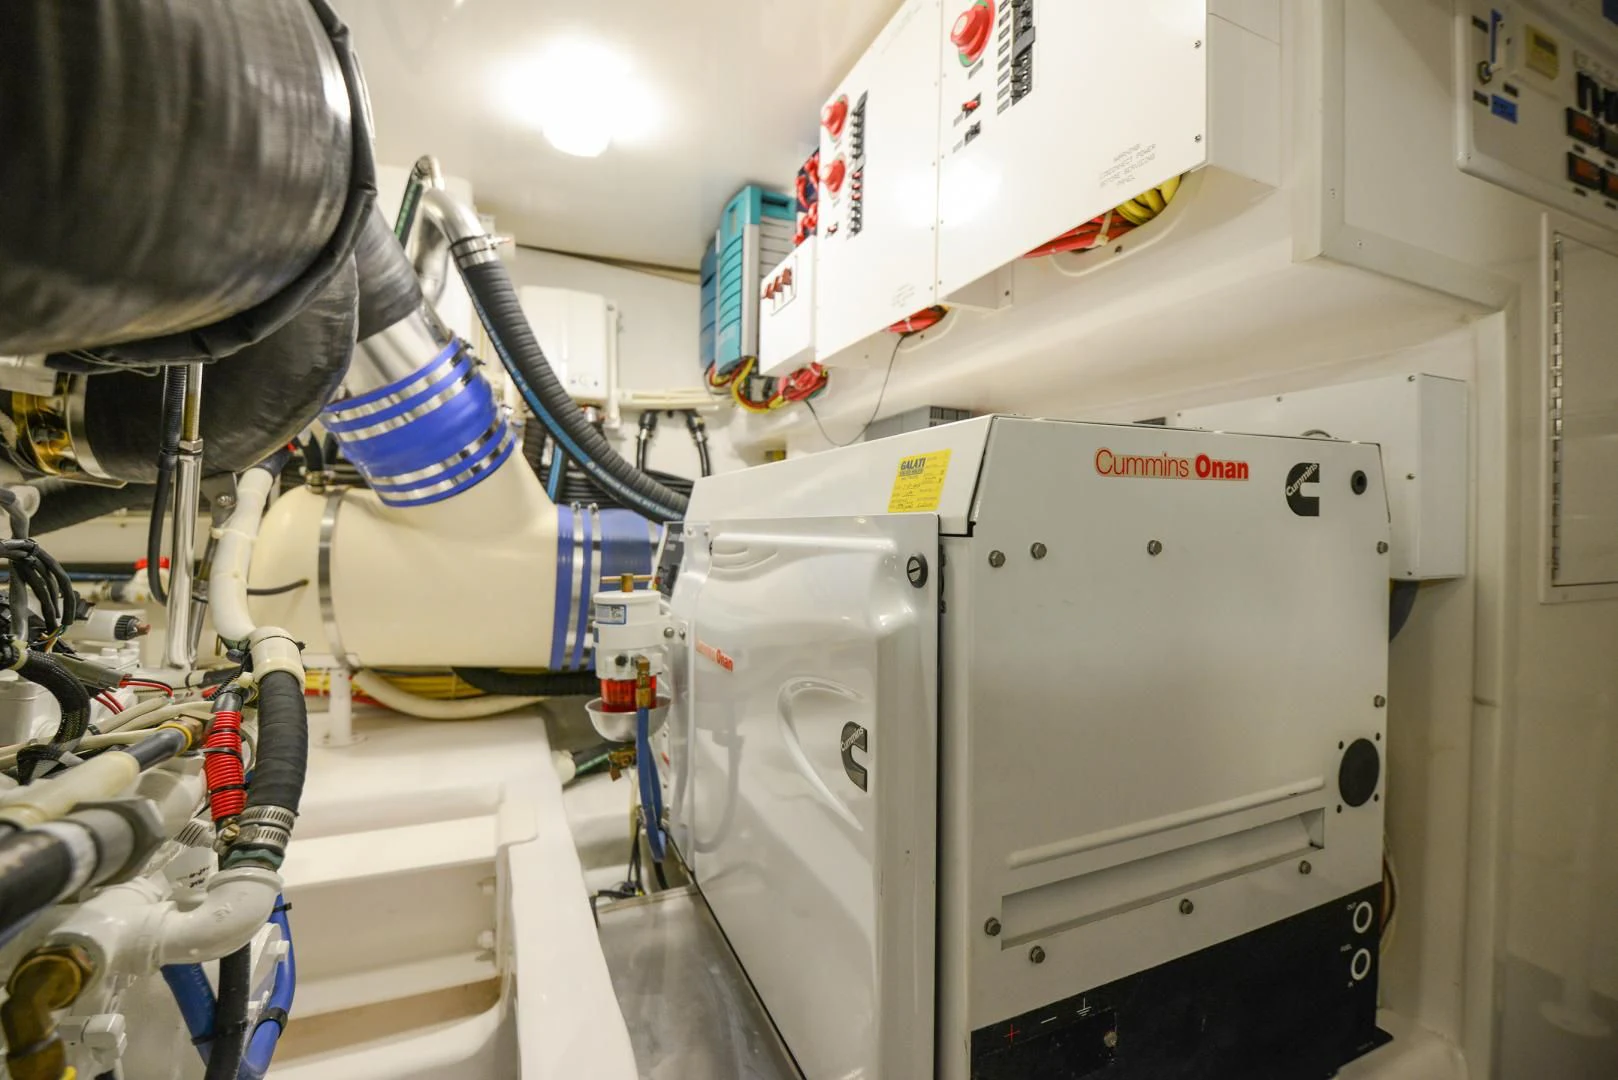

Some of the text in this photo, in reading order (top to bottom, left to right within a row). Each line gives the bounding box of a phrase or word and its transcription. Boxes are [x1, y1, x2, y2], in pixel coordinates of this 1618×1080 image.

[900, 457, 926, 471] GALATI
[1095, 448, 1249, 480] Cummins Onan
[1286, 462, 1318, 497] Cummins
[716, 648, 734, 672] Onan
